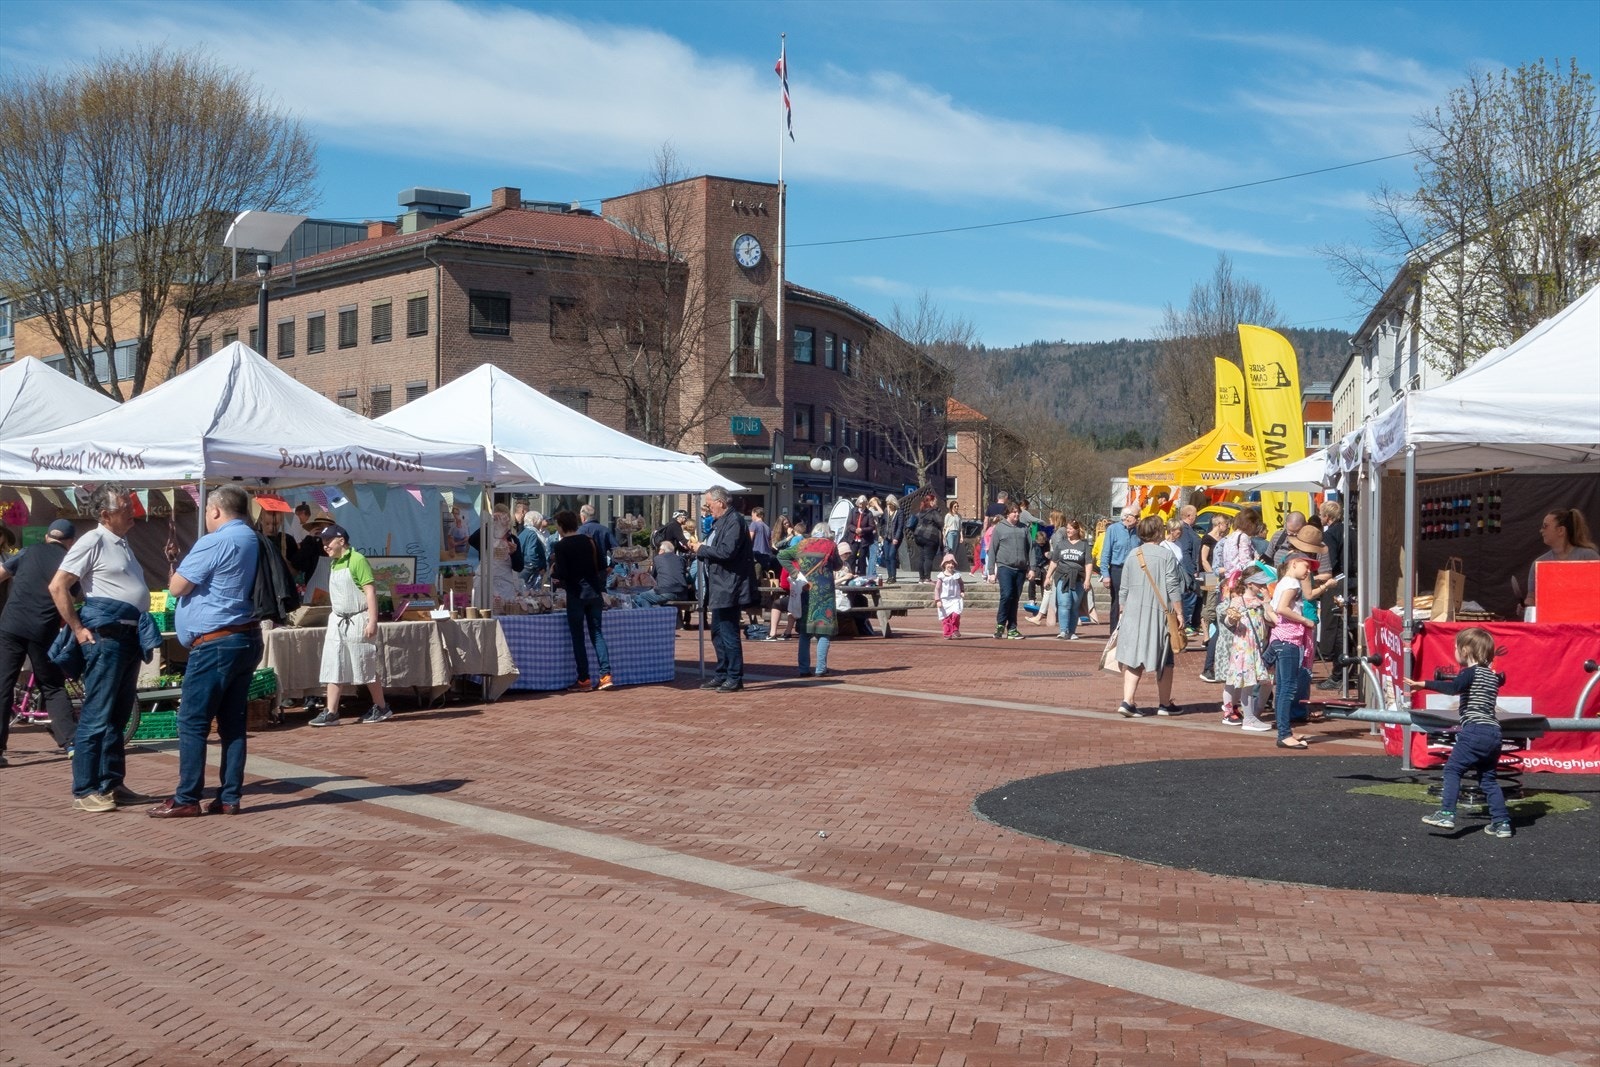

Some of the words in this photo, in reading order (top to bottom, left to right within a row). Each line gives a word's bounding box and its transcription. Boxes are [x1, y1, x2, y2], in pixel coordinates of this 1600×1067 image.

[736, 417, 759, 435] DNB
[31, 447, 86, 475] Bondens
[87, 448, 146, 471] marked
[278, 447, 353, 475] Bondens
[356, 452, 425, 473] marked
